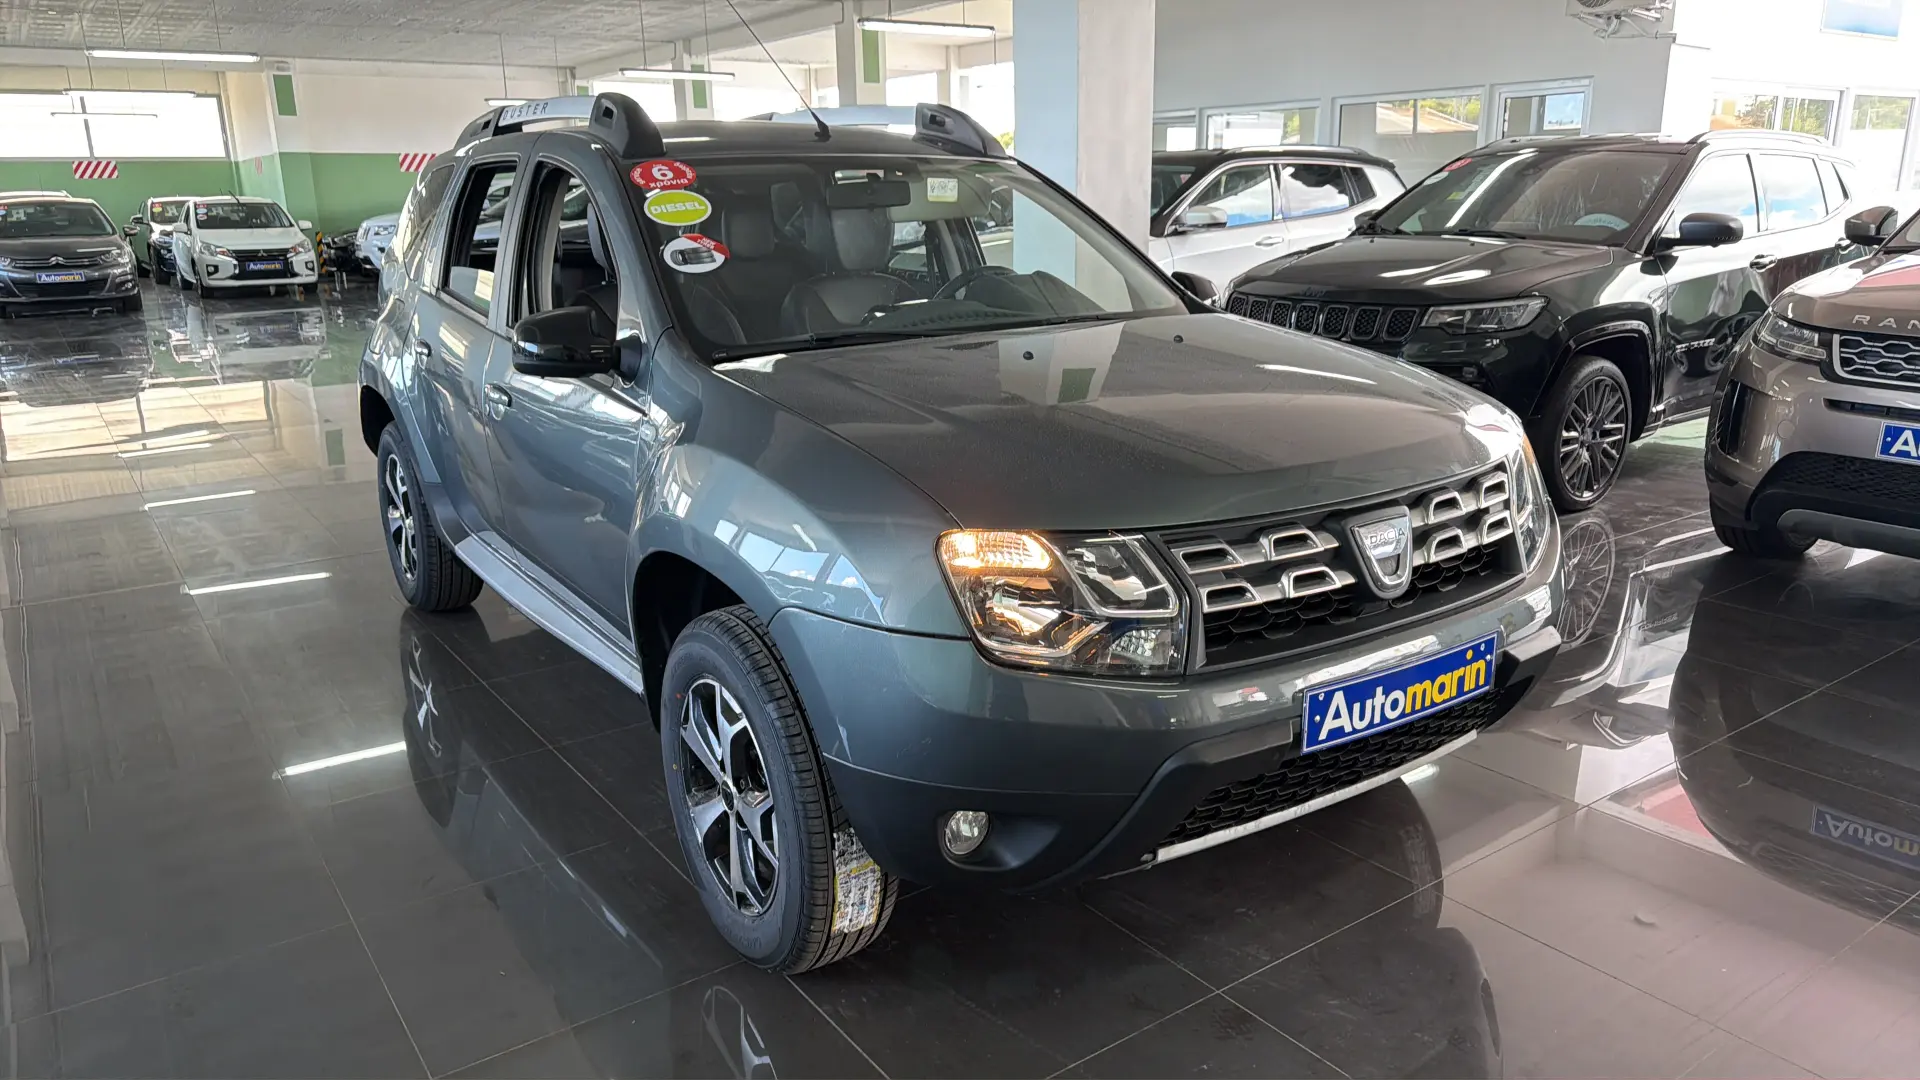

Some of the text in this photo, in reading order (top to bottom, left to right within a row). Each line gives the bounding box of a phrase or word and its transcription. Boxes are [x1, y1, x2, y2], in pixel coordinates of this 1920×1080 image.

[502, 102, 549, 120] DUSTER
[652, 165, 674, 181] 6
[649, 178, 689, 188] χρόνια
[650, 201, 706, 214] DIESEL
[249, 262, 281, 270] Automarin
[41, 273, 82, 282] Automarin
[1888, 429, 1920, 458] A
[1369, 527, 1405, 545] DACIA
[1318, 649, 1486, 741] Automarin
